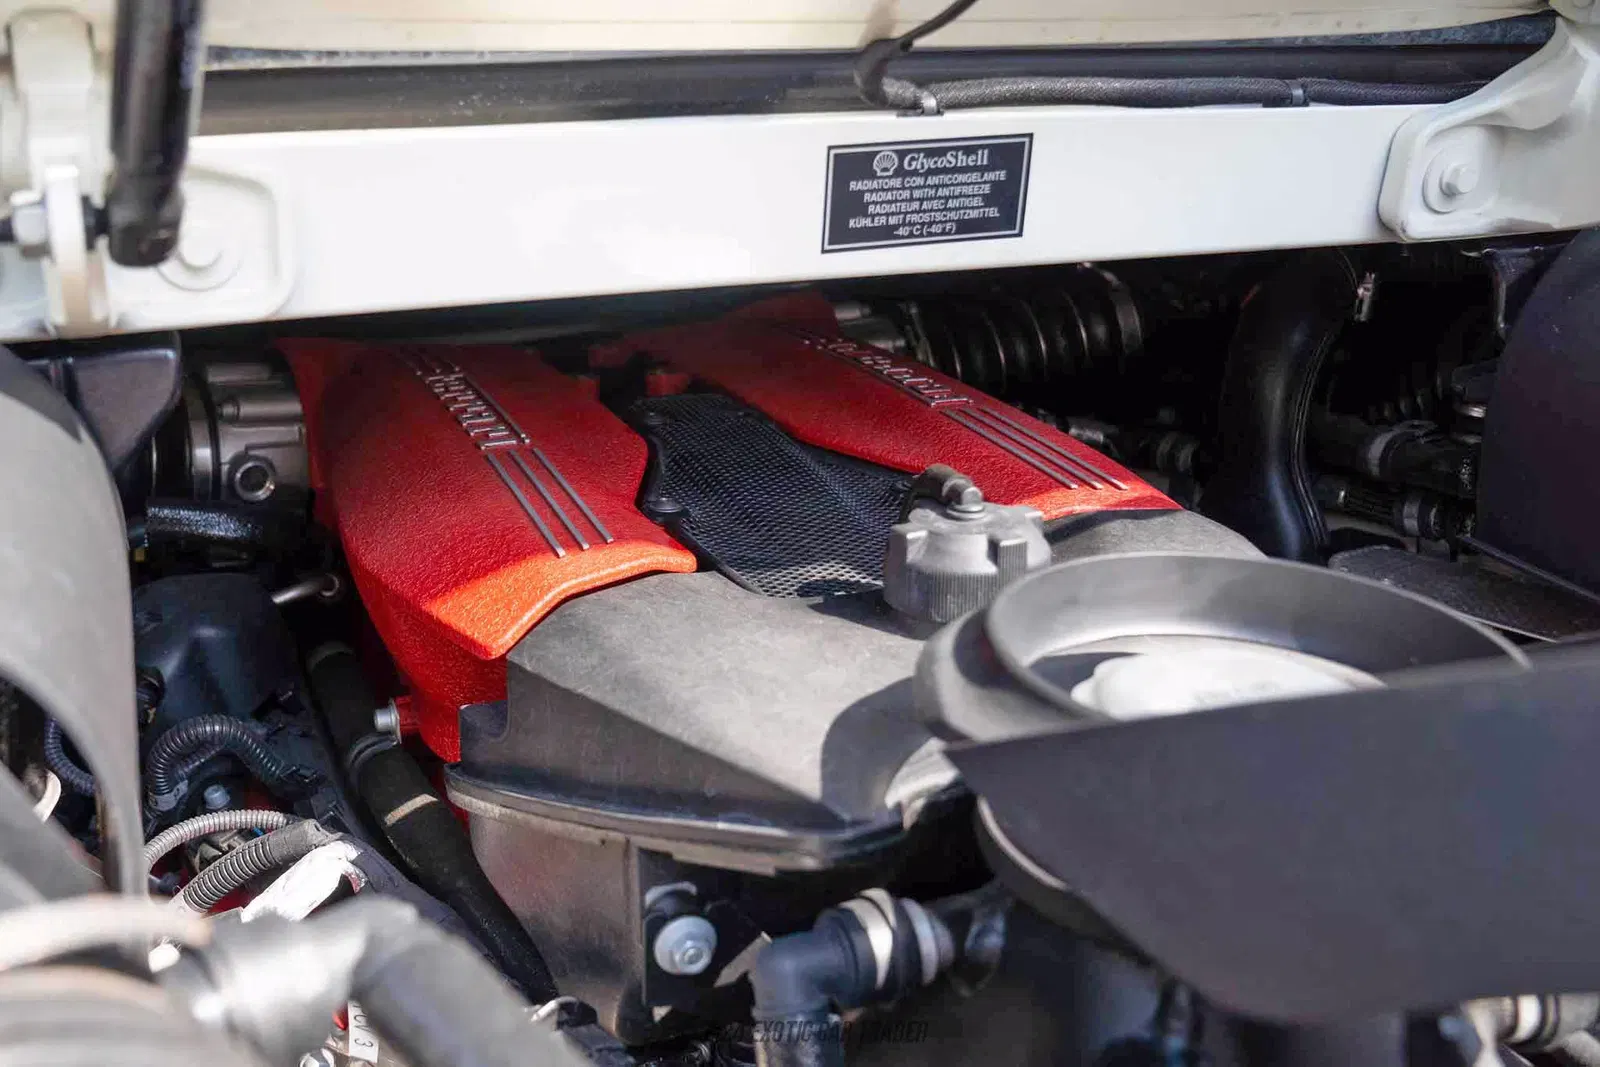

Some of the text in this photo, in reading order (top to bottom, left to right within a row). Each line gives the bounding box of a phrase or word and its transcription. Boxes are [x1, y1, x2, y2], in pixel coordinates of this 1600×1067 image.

[903, 149, 989, 173] GlycoShell
[849, 170, 1007, 191] RADIATORE CON ANTICONGELANTE
[864, 184, 991, 202] RADIATOR WITH ANTIFREEZE
[868, 197, 985, 215] RADIATEUR AVEC ANTIGEL
[849, 208, 1000, 228] KÜHLER MIT FROSTSCHUTZMITTEL
[354, 1038, 374, 1048] 3
